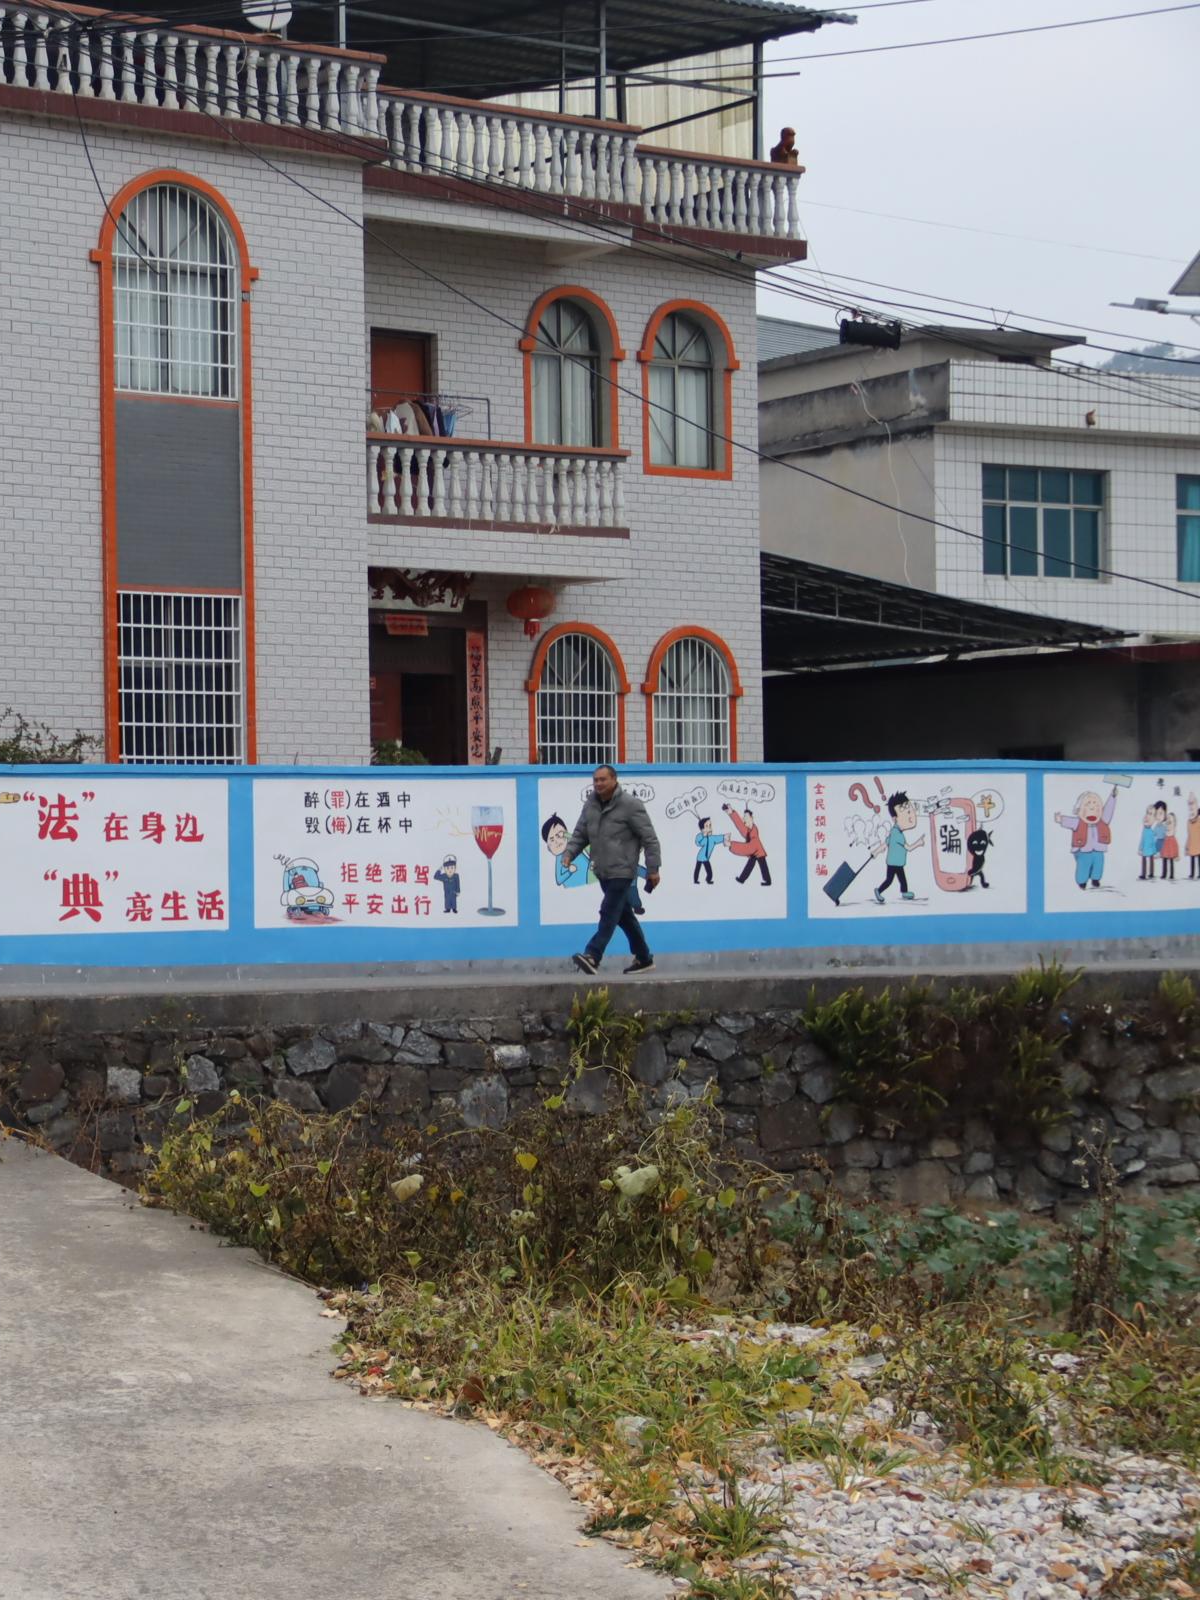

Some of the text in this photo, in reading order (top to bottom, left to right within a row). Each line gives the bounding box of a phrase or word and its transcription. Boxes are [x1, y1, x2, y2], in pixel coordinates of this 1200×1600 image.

[940, 824, 962, 855] 骗
[341, 894, 431, 916] 平安出行
